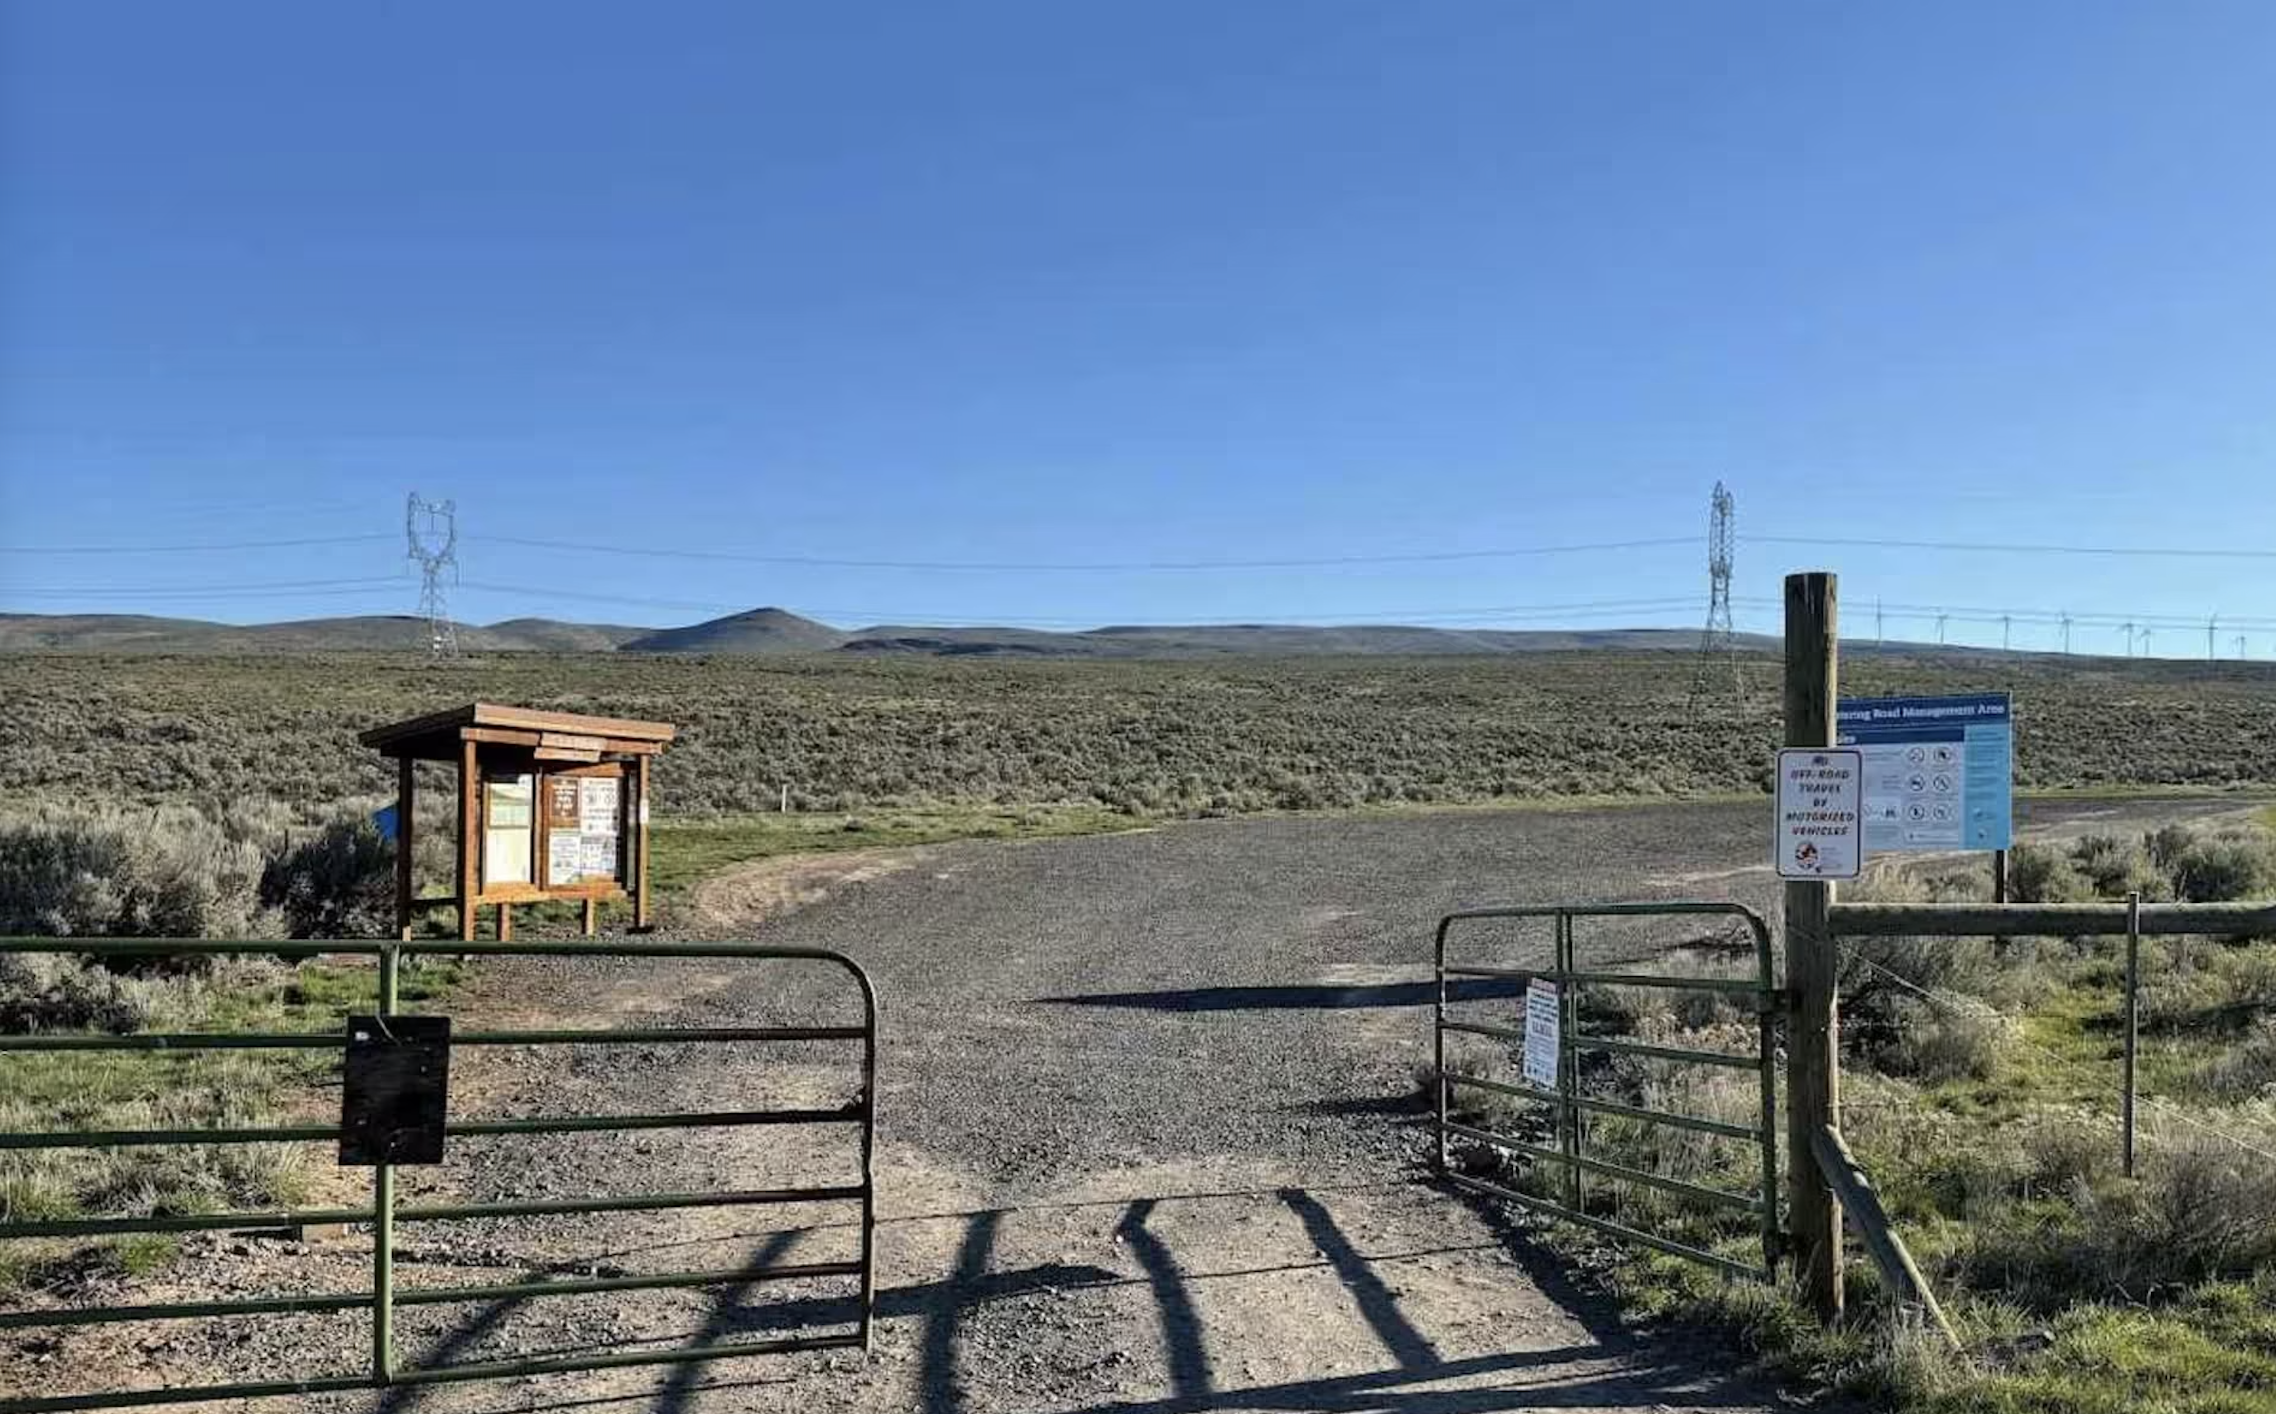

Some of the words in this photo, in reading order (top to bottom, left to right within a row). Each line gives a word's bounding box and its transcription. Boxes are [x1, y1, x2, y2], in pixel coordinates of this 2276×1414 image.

[1874, 708, 1900, 718] Road
[1903, 705, 1975, 718] Management
[1978, 704, 2005, 715] Area
[1790, 769, 1850, 780] OFF-ROAD
[1799, 783, 1841, 793] TRAVEL
[1813, 797, 1828, 807] BY
[1786, 811, 1856, 822] MOTORIZED
[1791, 826, 1849, 836] VEHICLES
